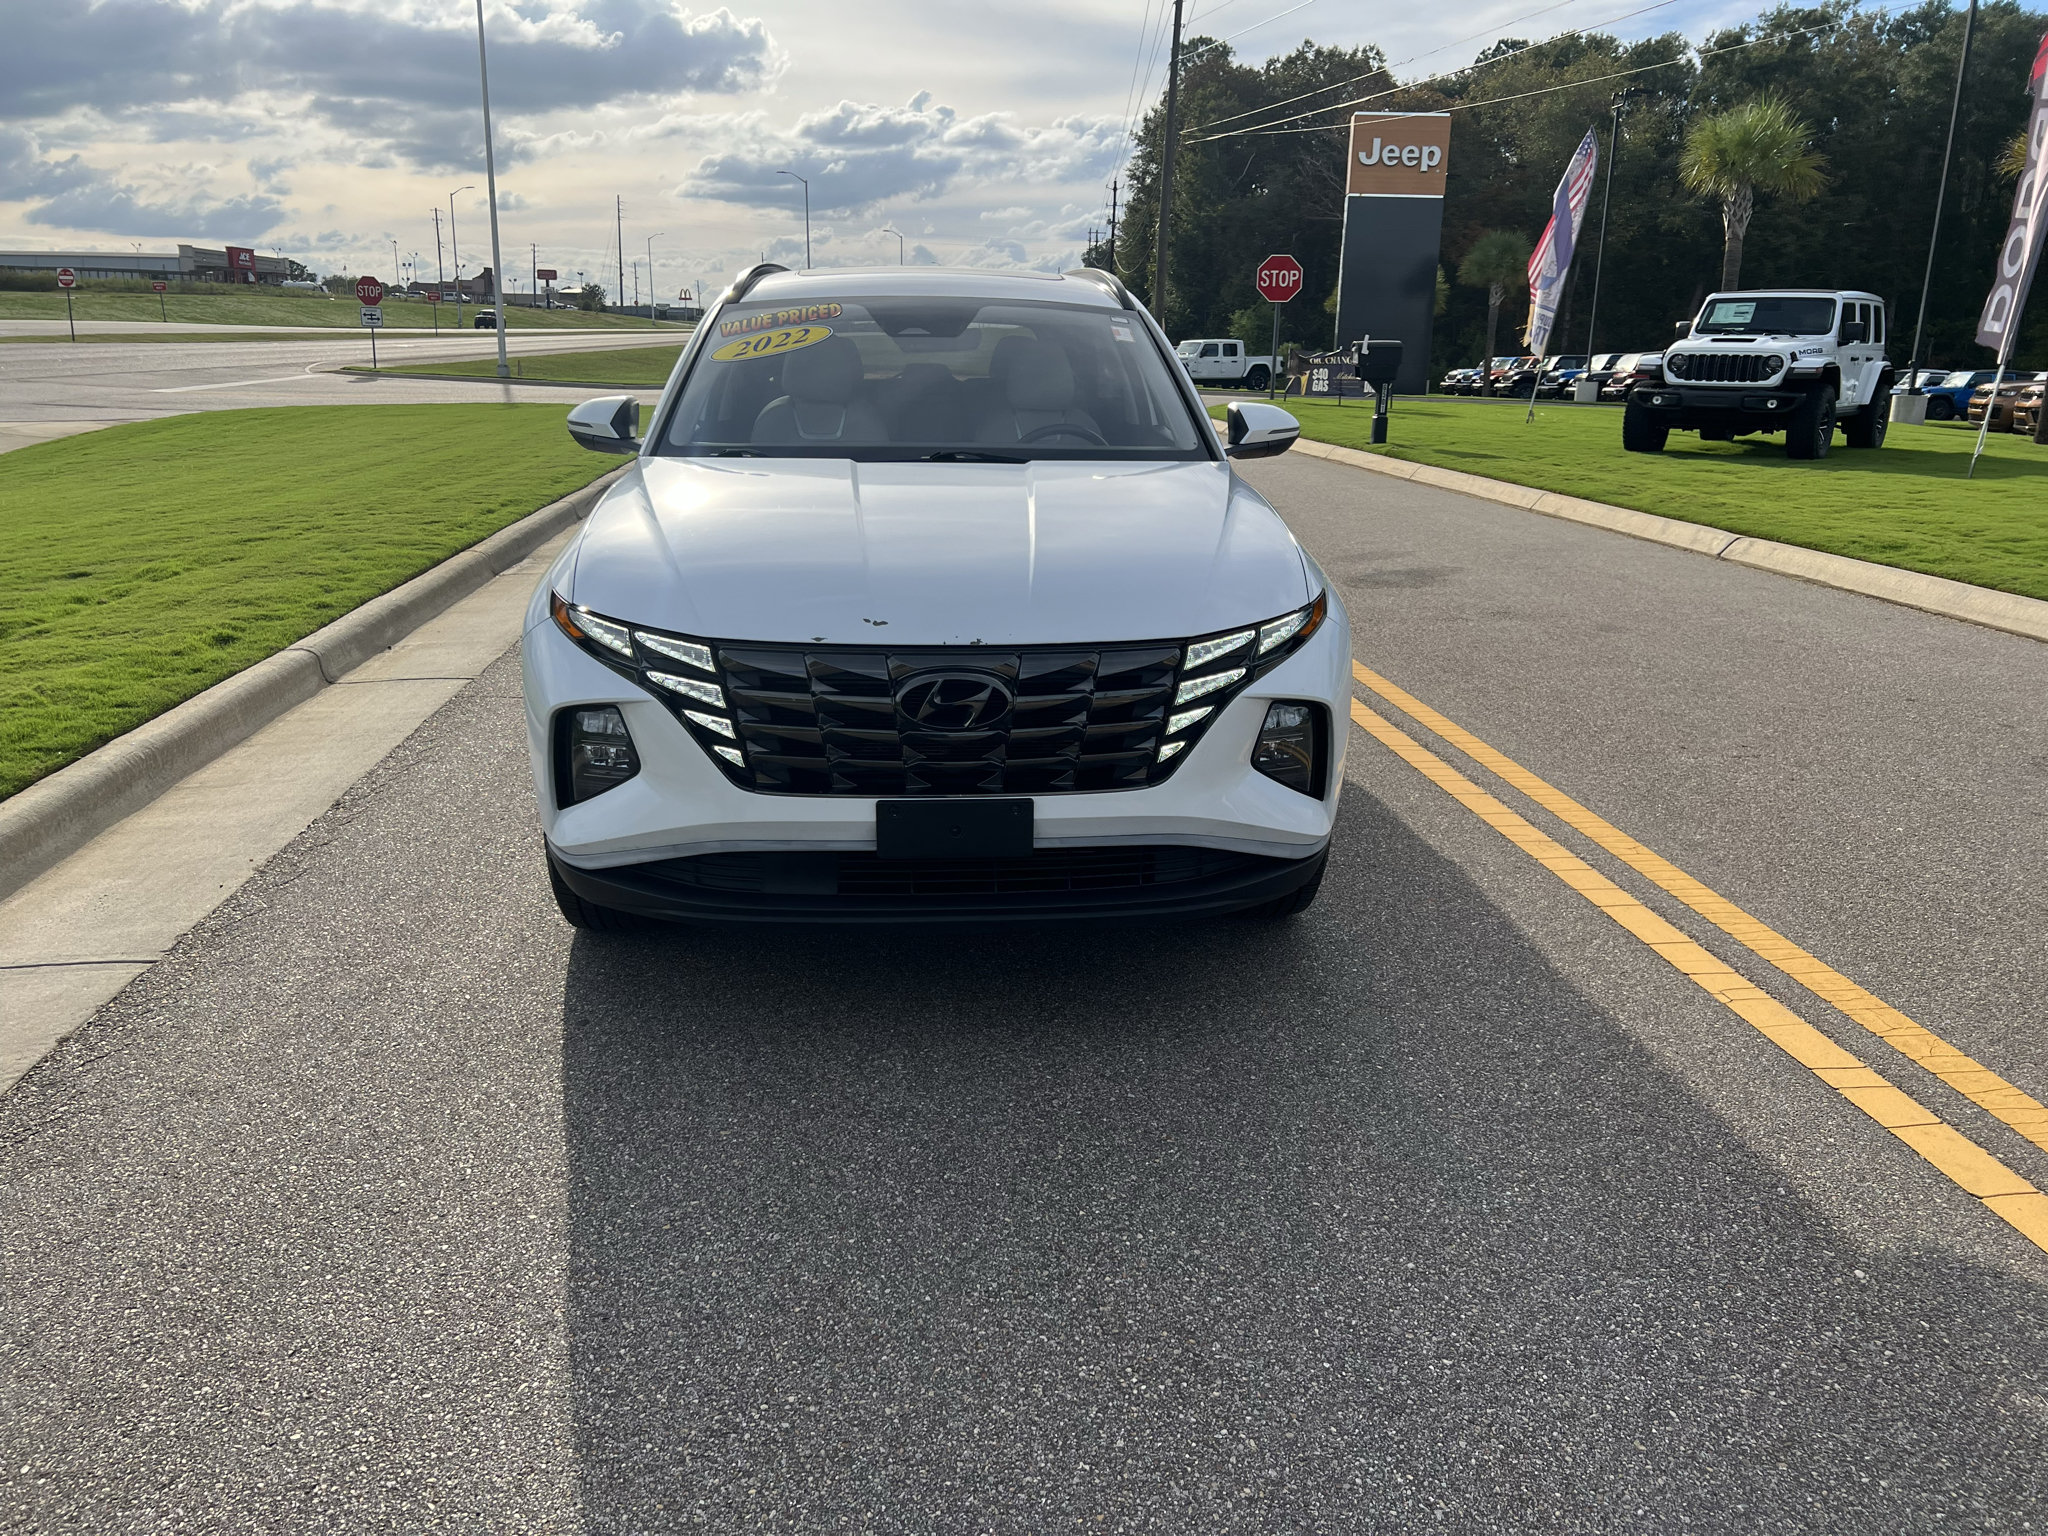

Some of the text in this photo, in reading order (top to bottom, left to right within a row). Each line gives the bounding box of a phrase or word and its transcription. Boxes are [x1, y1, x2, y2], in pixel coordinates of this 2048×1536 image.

[1358, 137, 1442, 172] Jeep
[1983, 62, 2048, 333] DODG
[1260, 270, 1300, 287] STOP
[357, 285, 382, 297] STOP
[720, 303, 843, 338] VALUE PRICED
[732, 328, 811, 358] 2022
[1325, 355, 1354, 365] CHANG
[1312, 380, 1329, 392] GAS
